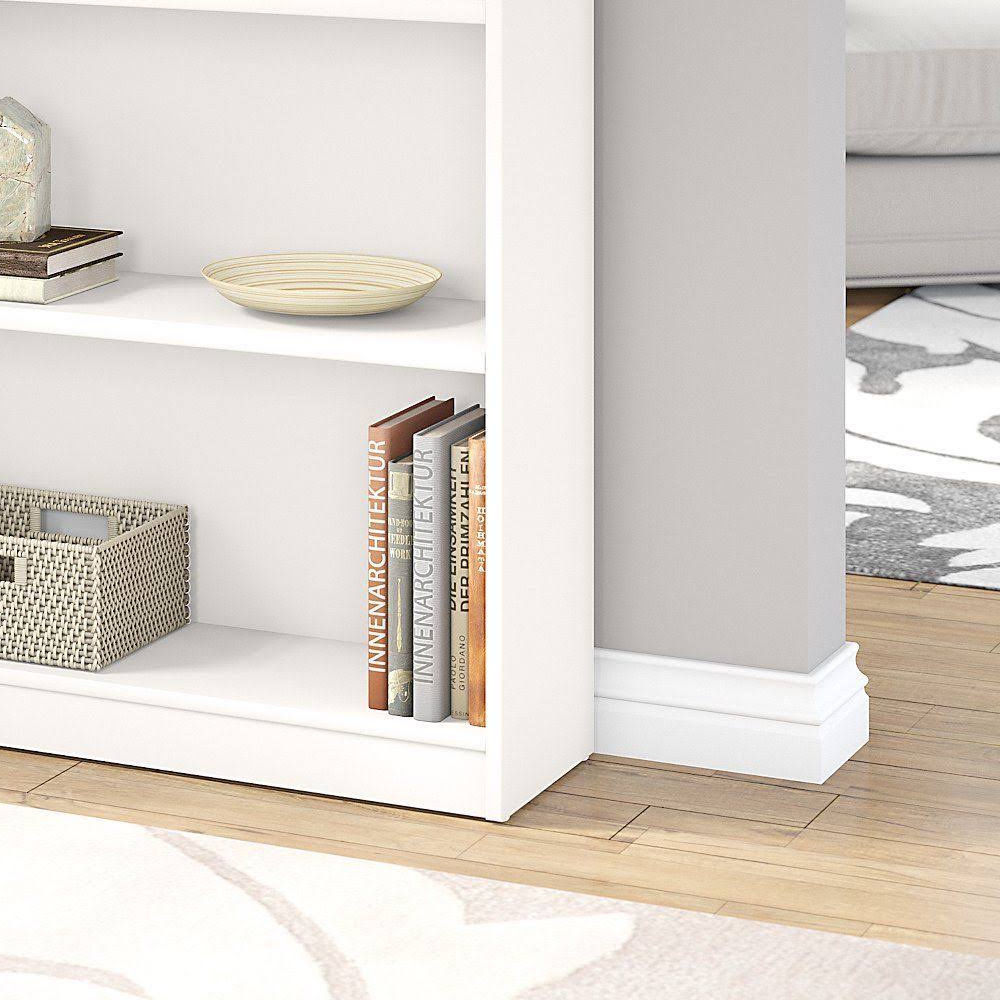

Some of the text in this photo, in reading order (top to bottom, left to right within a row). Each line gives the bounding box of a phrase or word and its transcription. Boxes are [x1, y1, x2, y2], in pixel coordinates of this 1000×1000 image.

[368, 439, 386, 673] INNENARCHITEKTUR
[389, 548, 411, 560] WORK
[413, 447, 434, 685] INNENARCHITEKTUR
[460, 450, 469, 612] DER PRIMZAHLEN
